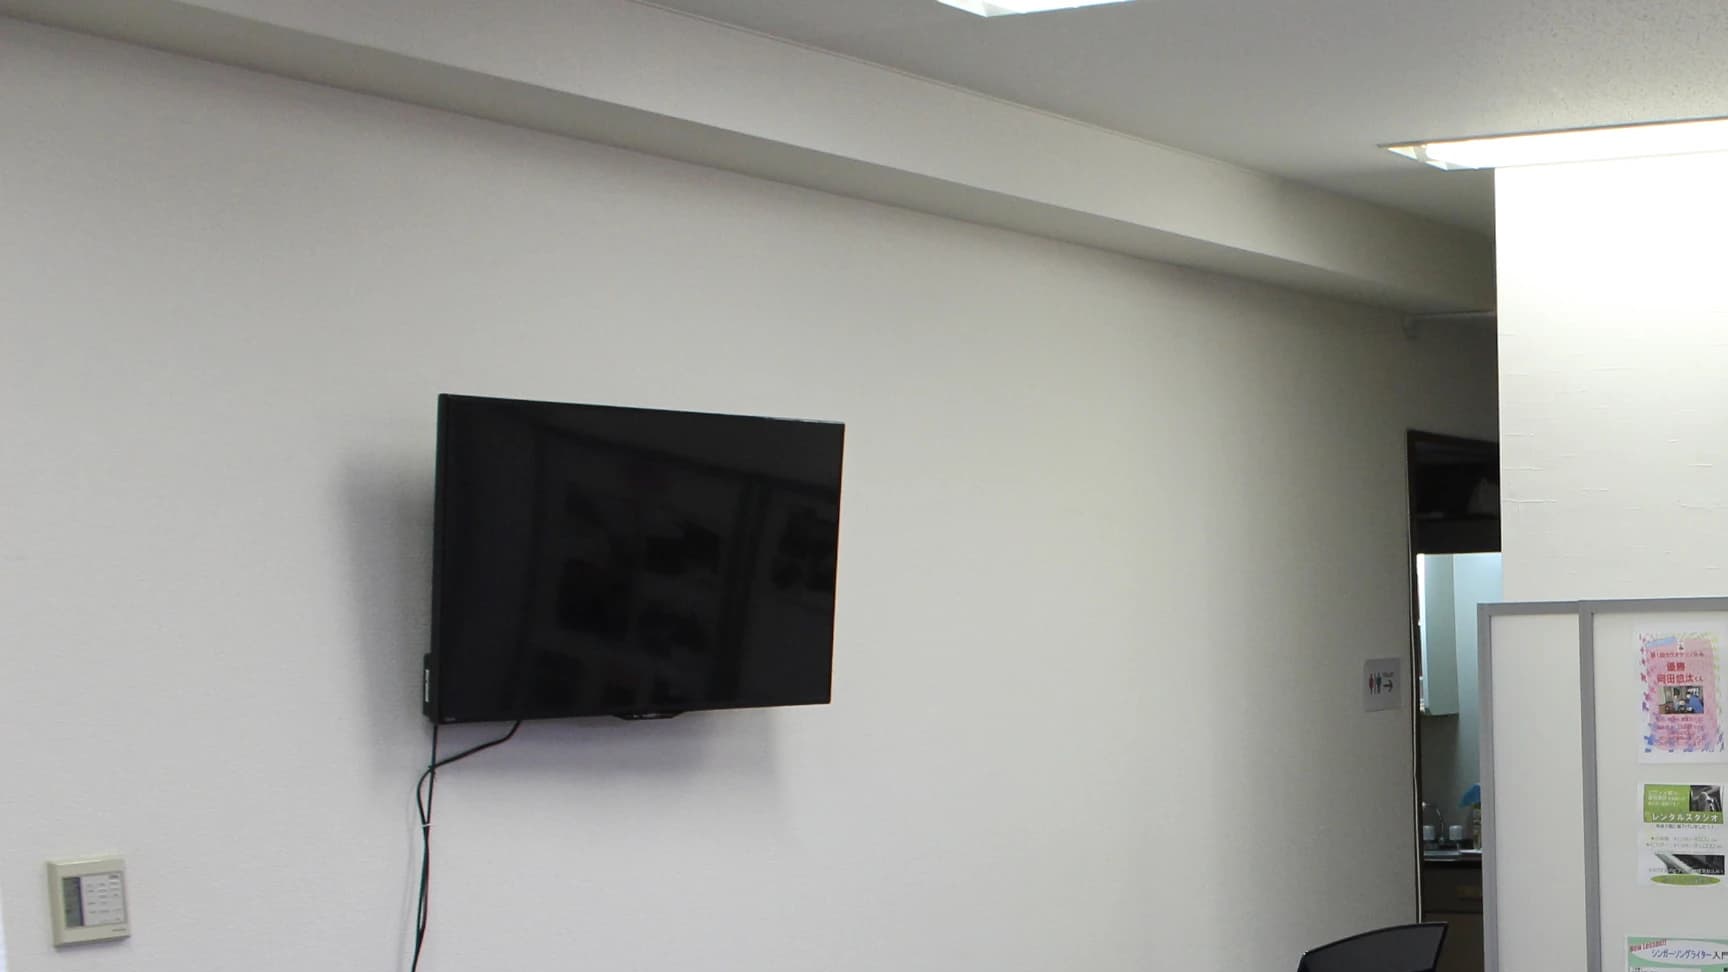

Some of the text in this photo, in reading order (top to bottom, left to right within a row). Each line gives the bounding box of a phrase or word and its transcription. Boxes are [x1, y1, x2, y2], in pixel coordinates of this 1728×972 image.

[1652, 813, 1719, 823] レンタルスタジオ
